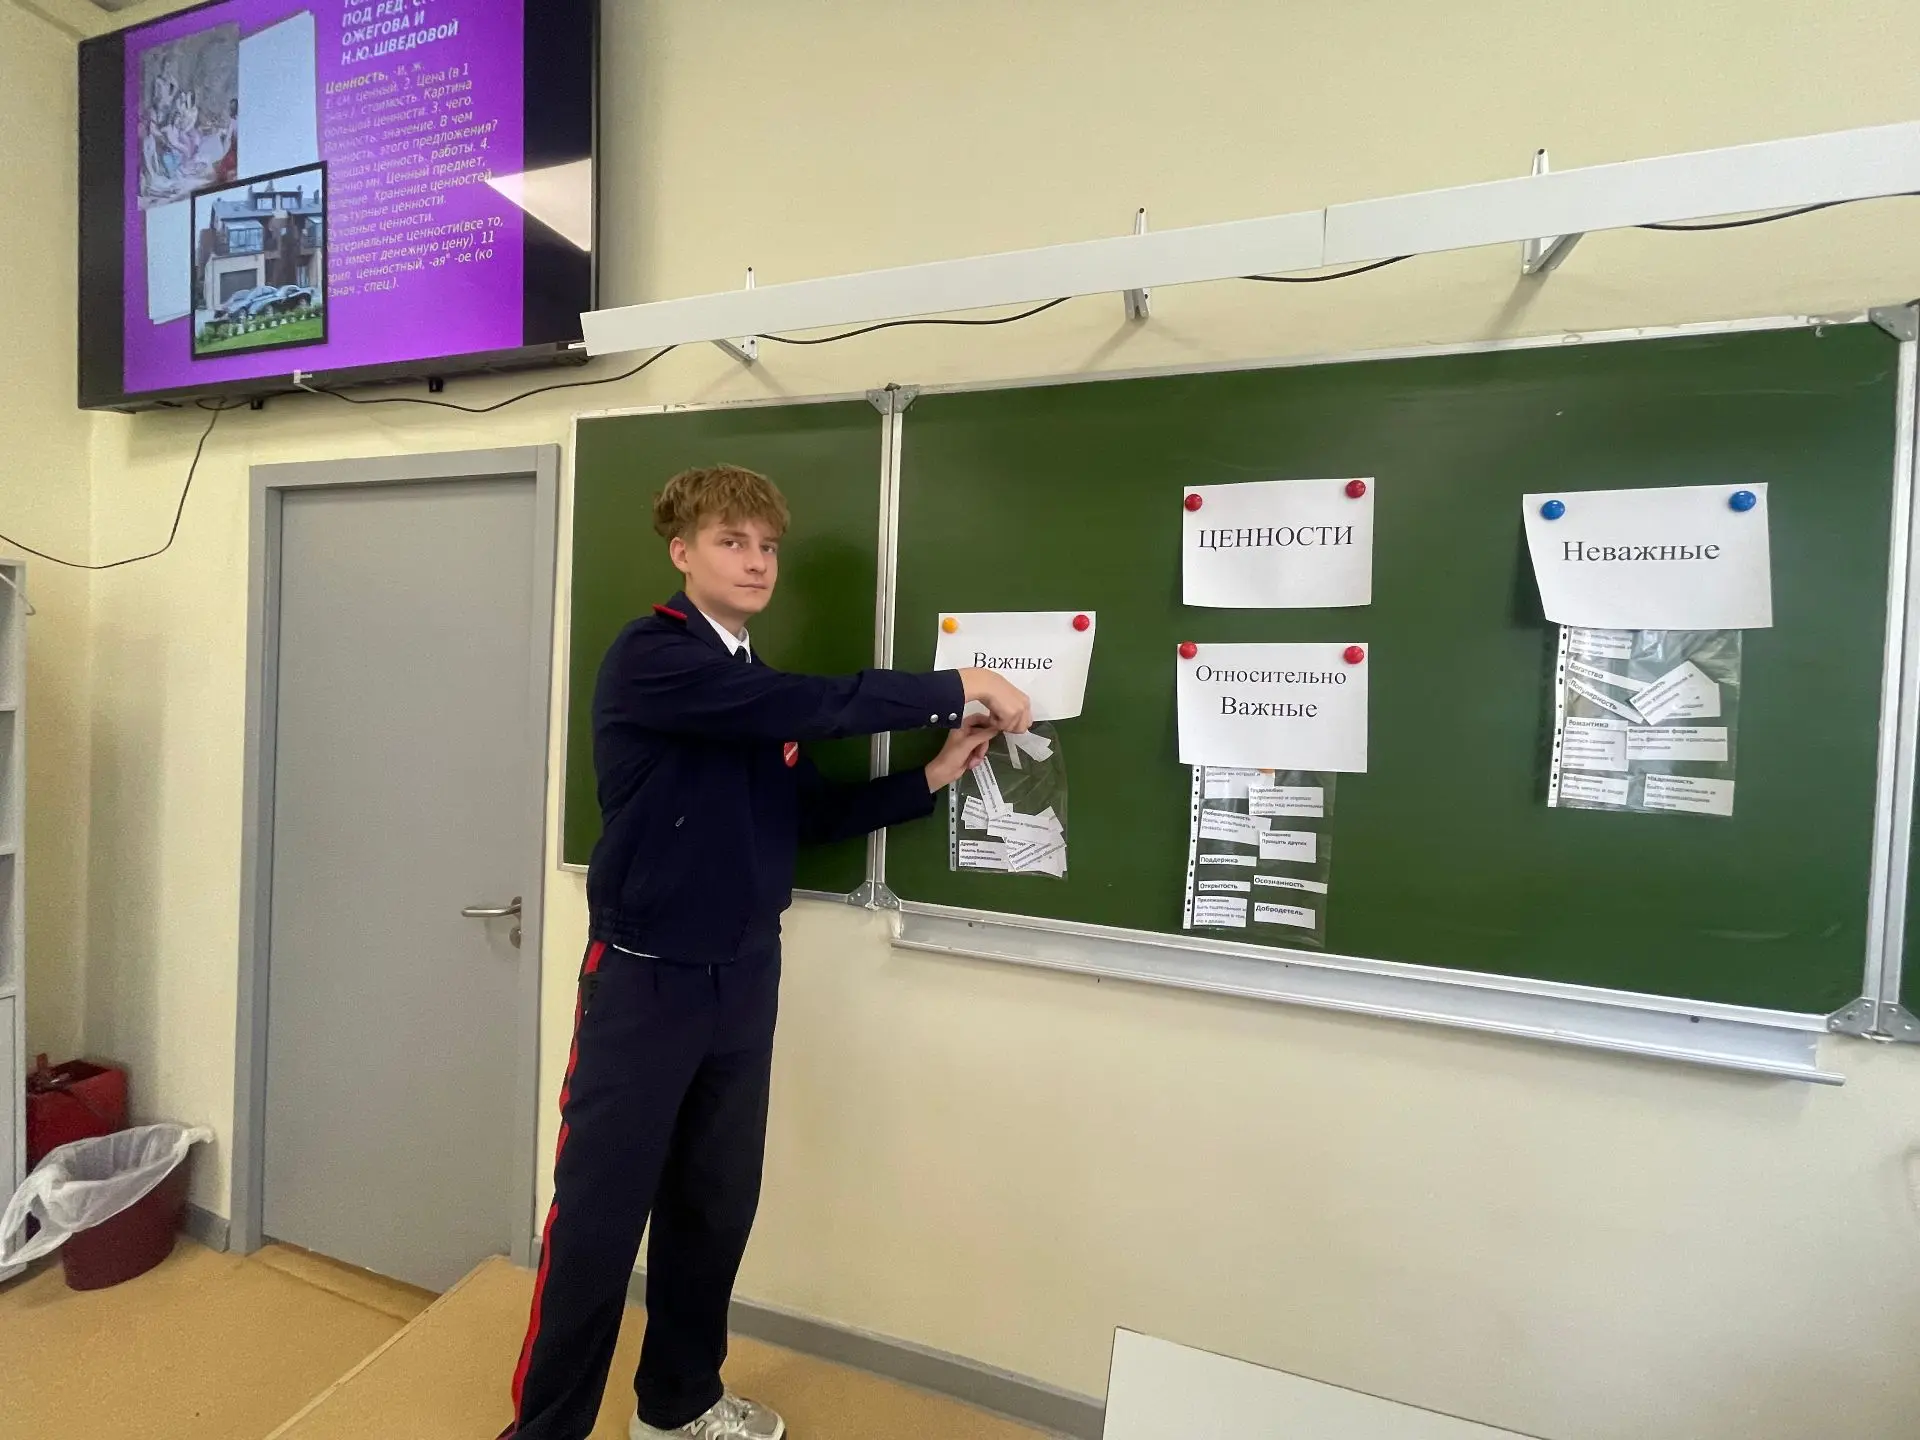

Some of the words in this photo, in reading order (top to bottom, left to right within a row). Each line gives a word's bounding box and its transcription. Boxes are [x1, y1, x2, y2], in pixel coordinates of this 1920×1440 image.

[342, 8, 372, 27] ПОД
[376, 0, 408, 18] РЕД.
[342, 15, 410, 46] ОЖЕГОВА
[415, 10, 425, 25] И
[341, 19, 459, 66] Н.Ю.ШВЕДОВОЙ
[417, 70, 445, 87] Цена
[449, 67, 459, 81] (в
[463, 63, 469, 76] 1
[424, 80, 472, 100] Картина
[432, 101, 441, 113] 3.
[440, 115, 447, 127] В
[451, 111, 473, 124] чем
[412, 119, 497, 149] предложения?
[431, 141, 476, 160] работы.
[481, 137, 490, 150] 4.
[386, 168, 429, 185] Ценный
[433, 156, 486, 176] предмет,
[391, 195, 447, 214] ценности.
[379, 214, 434, 231] ценности.
[406, 219, 484, 241] ценности(все
[488, 216, 504, 228] то,
[380, 242, 439, 262] денежную
[454, 249, 472, 263] -ое
[475, 248, 493, 262] (ко
[1198, 526, 1355, 551] ЦЕННОСТИ
[1561, 541, 1721, 561] Неважные
[973, 652, 1053, 671] Важные
[1570, 662, 1604, 679] Богатство
[1195, 665, 1347, 685] Относительно
[1570, 679, 1618, 710] Популярность
[1220, 696, 1318, 718] Важные
[1568, 719, 1609, 728] Романтика
[1254, 877, 1305, 888] Осознанность
[1256, 905, 1303, 915] Добродетель
